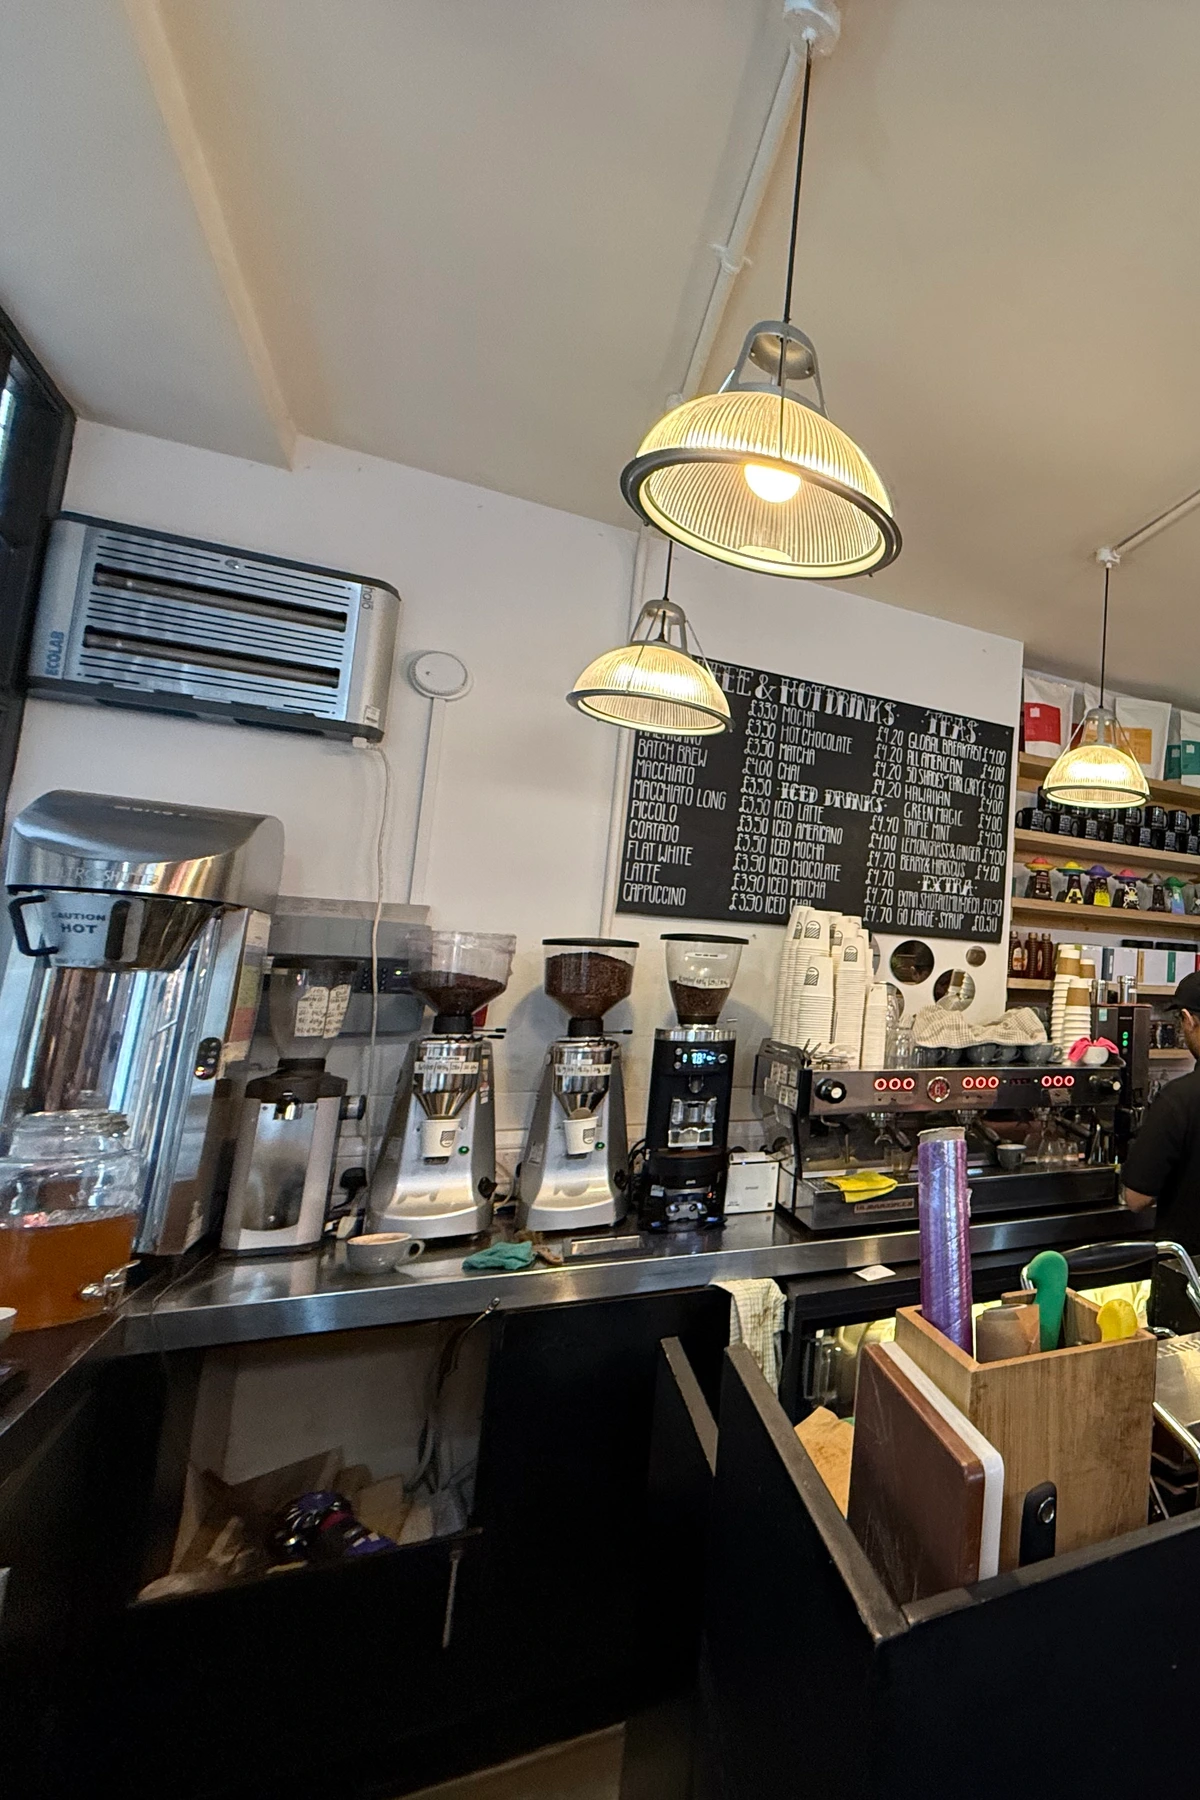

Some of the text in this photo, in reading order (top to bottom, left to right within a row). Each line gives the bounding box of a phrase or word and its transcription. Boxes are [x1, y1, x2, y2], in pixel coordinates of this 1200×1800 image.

[45, 631, 64, 675] ECOLAB
[754, 674, 780, 700] &
[780, 678, 826, 712] HOT
[825, 687, 898, 726] DRINKS
[781, 706, 815, 729] MOCHA
[924, 710, 979, 743] TEAS
[780, 725, 800, 747] HOT
[801, 728, 853, 755] CHOCOLATE
[908, 731, 940, 754] GLOBAL
[942, 738, 983, 762] BREAKFAST
[637, 738, 675, 762] BATCH
[676, 744, 708, 768] BREW
[778, 743, 816, 766] MATCHA
[906, 749, 920, 767] ALL
[920, 751, 963, 775] AMERICAN
[634, 759, 696, 785] MACCHIATO
[777, 762, 801, 782] CHAI
[632, 778, 695, 806] MACCHIATO
[696, 788, 727, 811] LONG
[781, 782, 885, 814] ICED DRINKS
[904, 784, 951, 807] HAWAIIAN
[963, 777, 982, 797] GREY
[630, 799, 678, 823] PICCOLO
[773, 800, 795, 819] ICED
[797, 803, 825, 824] LATTE
[903, 801, 933, 823] GREEN
[934, 806, 964, 827] MAGIC
[629, 819, 680, 843] CORTADO
[771, 819, 793, 839] ICED
[794, 823, 844, 845] AMERICANO
[903, 818, 929, 839] TRIPLE
[930, 822, 952, 842] MINT
[627, 840, 657, 862] FLAT
[657, 843, 694, 866] WHITE
[770, 837, 791, 857] ICED
[791, 840, 825, 862] MOCHA
[624, 861, 662, 884] LATTE
[768, 856, 789, 877] ICED
[790, 859, 842, 883] CHOCOLATE
[931, 858, 966, 878] HIBISCUS
[622, 882, 687, 907] CAPPUCCINO
[766, 876, 788, 896] ICED
[789, 879, 827, 900] MATCHA
[921, 874, 974, 897] EXTRA
[764, 895, 786, 915] ICED
[897, 890, 919, 909] EXTRA
[61, 923, 98, 934] HOT
[896, 908, 907, 925] GO
